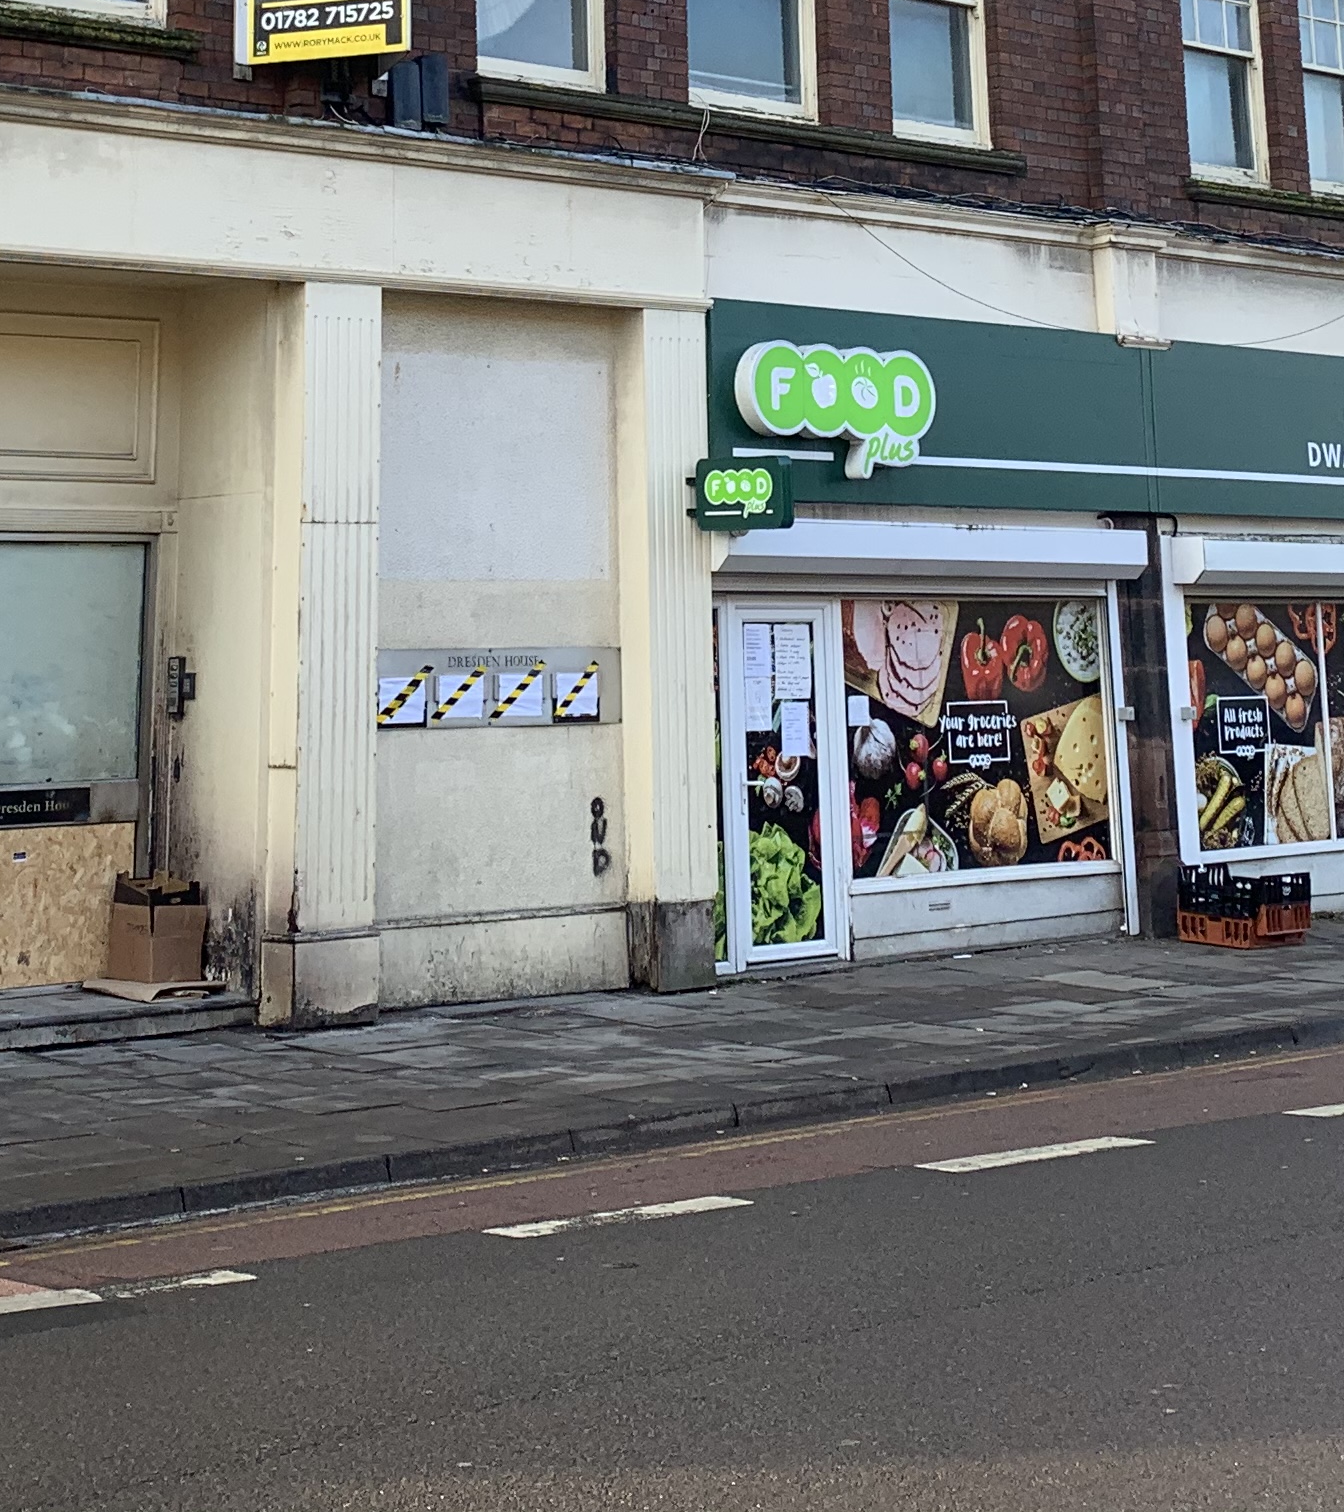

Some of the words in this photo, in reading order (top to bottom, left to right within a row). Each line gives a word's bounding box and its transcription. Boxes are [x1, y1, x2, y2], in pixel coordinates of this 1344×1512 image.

[261, 8, 320, 31] 01782
[325, 0, 394, 25] 715725
[863, 433, 916, 475] plus
[447, 655, 501, 668] DRESDEN
[967, 712, 1017, 731] groceries
[1224, 707, 1236, 723] All
[1238, 707, 1263, 723] fresh
[956, 734, 974, 748] are
[977, 732, 1002, 747] here!
[1224, 724, 1264, 741] products
